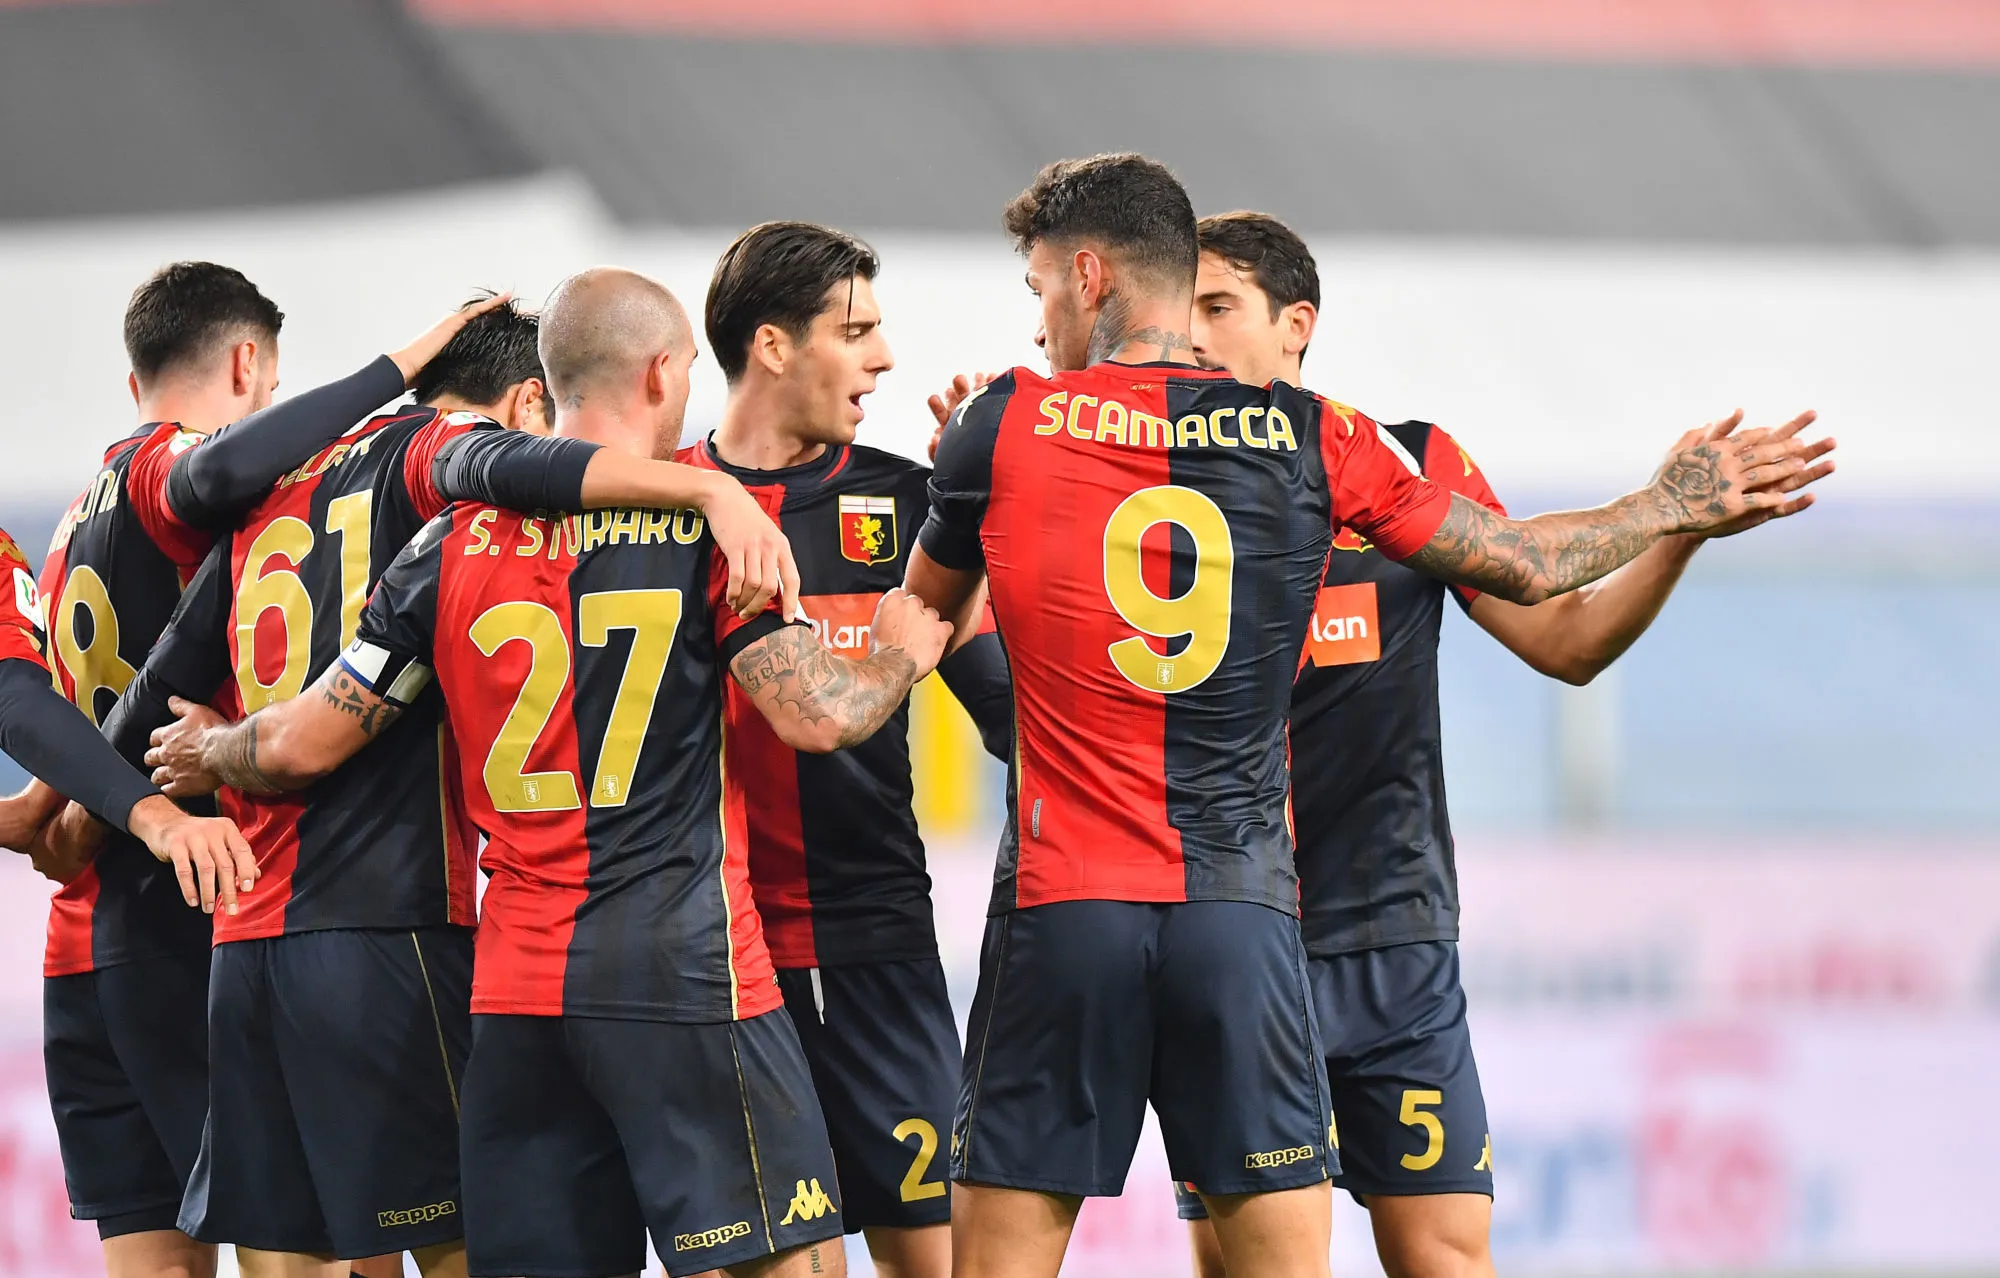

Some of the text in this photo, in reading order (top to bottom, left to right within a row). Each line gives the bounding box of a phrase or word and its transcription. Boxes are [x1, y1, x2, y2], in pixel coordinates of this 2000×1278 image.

[1034, 391, 1298, 452] SCAMACCA
[464, 509, 500, 556] S.
[227, 489, 375, 717] 61
[1103, 485, 1234, 693] 9
[468, 589, 683, 813] 27
[892, 1117, 947, 1203] 2
[1245, 1144, 1314, 1170] Kappa
[1399, 1090, 1445, 1171] 5
[378, 1199, 457, 1227] Kappa
[674, 1219, 752, 1252] Kappa
